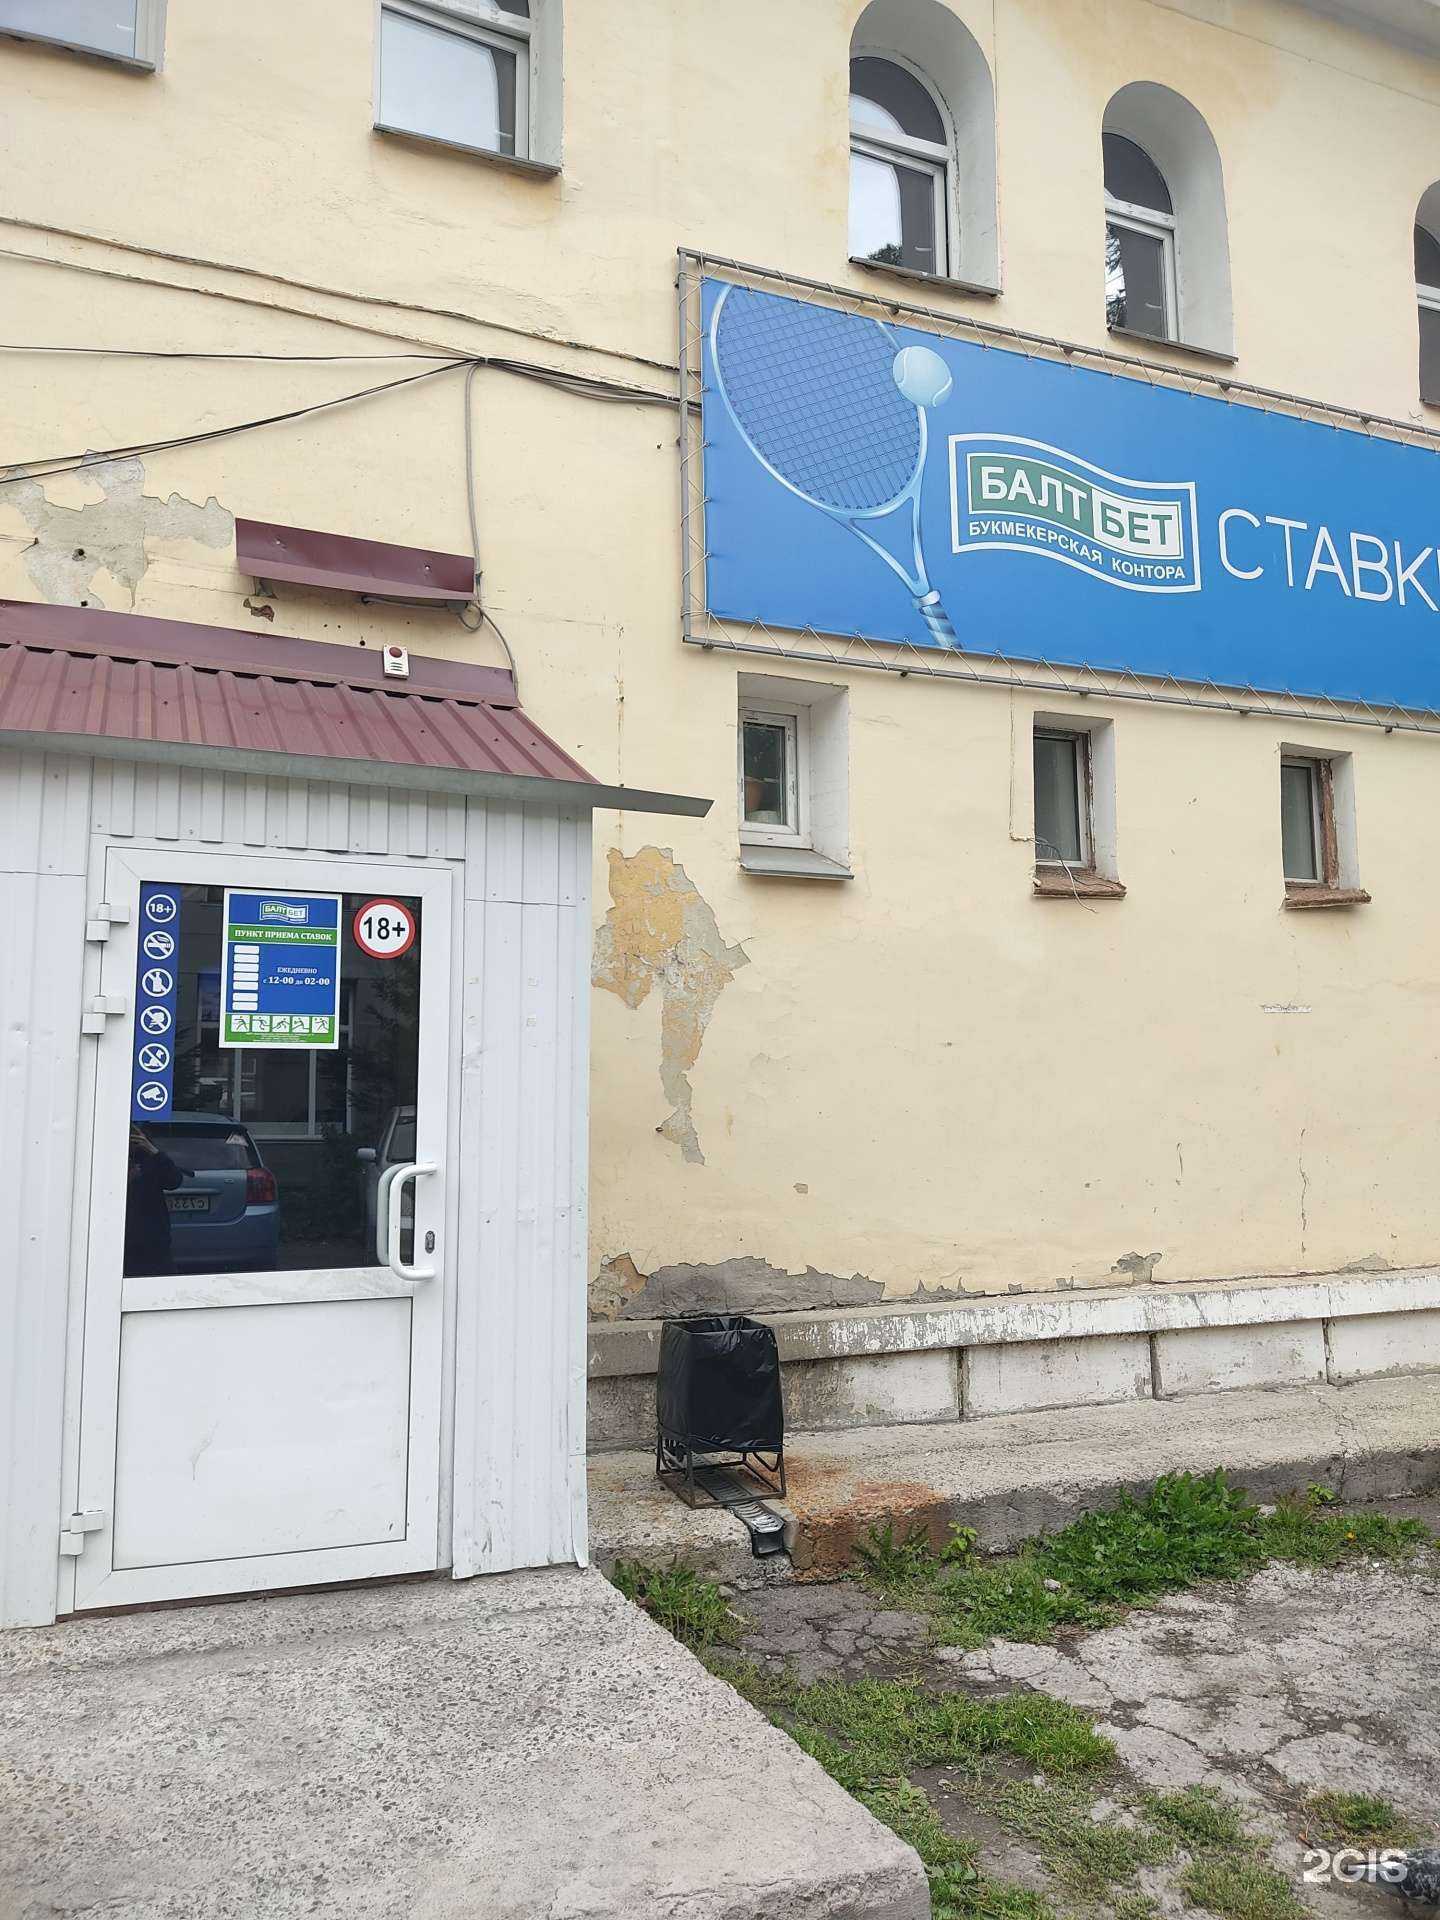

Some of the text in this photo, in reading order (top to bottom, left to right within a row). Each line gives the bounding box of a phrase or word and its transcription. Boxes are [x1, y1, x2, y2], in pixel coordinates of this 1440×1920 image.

[968, 521, 1186, 580] БУКМЕКЕРСКАЯ КОНТОРА
[1218, 508, 1440, 612] СТАВК
[150, 903, 172, 913] 18+
[363, 917, 406, 940] 18+
[234, 929, 332, 941] ПУНКТ ПРИЕМА СТАВОК
[277, 966, 318, 975] ЕЖЕДНЕВНО
[268, 976, 294, 984] 12-00
[304, 978, 330, 986] 02-00
